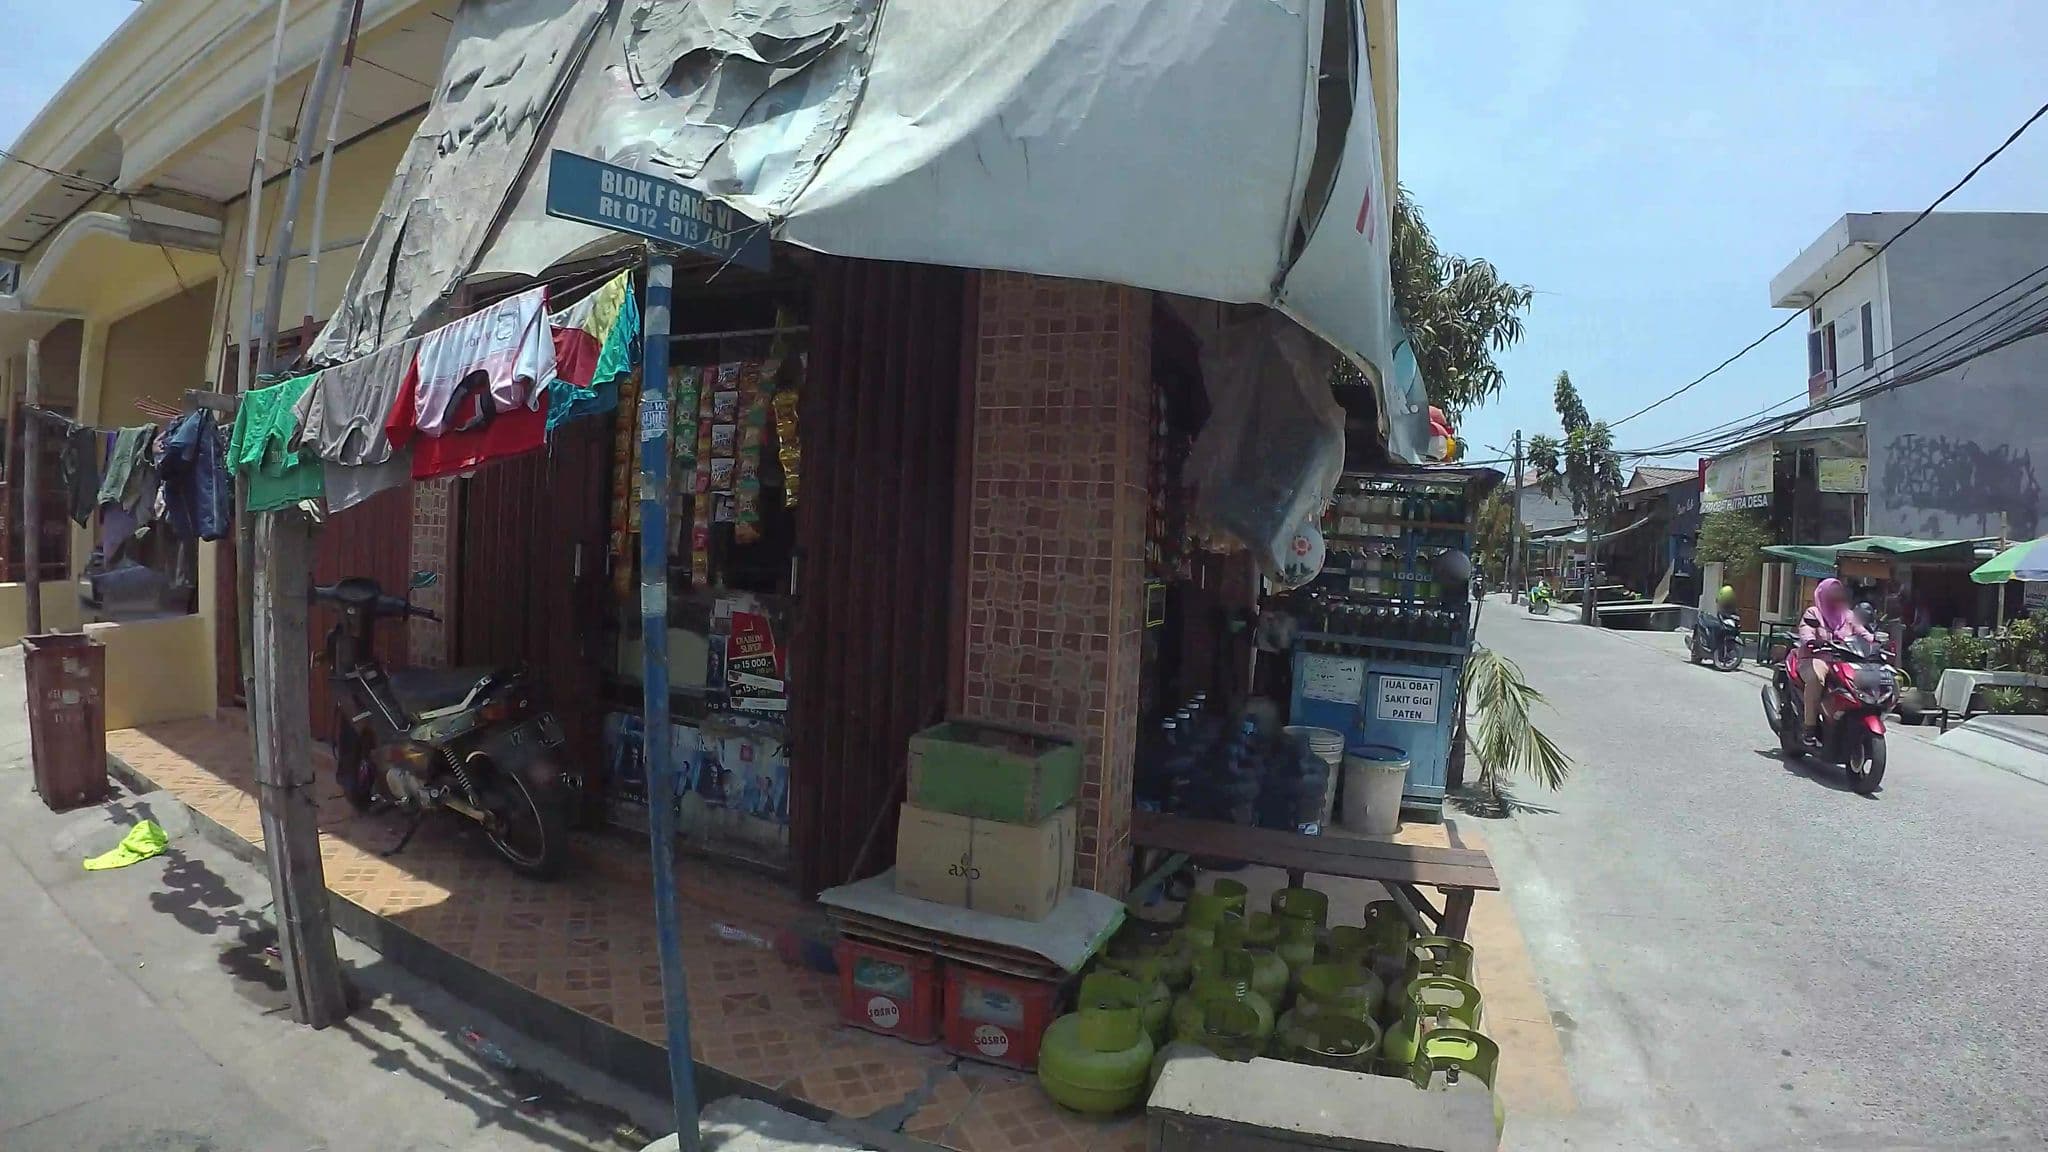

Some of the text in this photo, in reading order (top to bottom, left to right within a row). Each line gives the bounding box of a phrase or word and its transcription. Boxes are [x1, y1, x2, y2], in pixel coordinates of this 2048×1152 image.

[601, 170, 651, 204] BLOK
[655, 184, 666, 207] F
[668, 189, 713, 224] GANG
[600, 196, 621, 219] Rt
[625, 203, 657, 229] 012
[1747, 495, 1769, 508] DESA
[1385, 680, 1435, 692] JUAL OBAT
[1384, 694, 1432, 706] SAKIT GIGI
[1392, 709, 1422, 719] PATEN
[868, 1006, 898, 1017] SOSRO
[975, 1034, 1007, 1046] SOSRO
